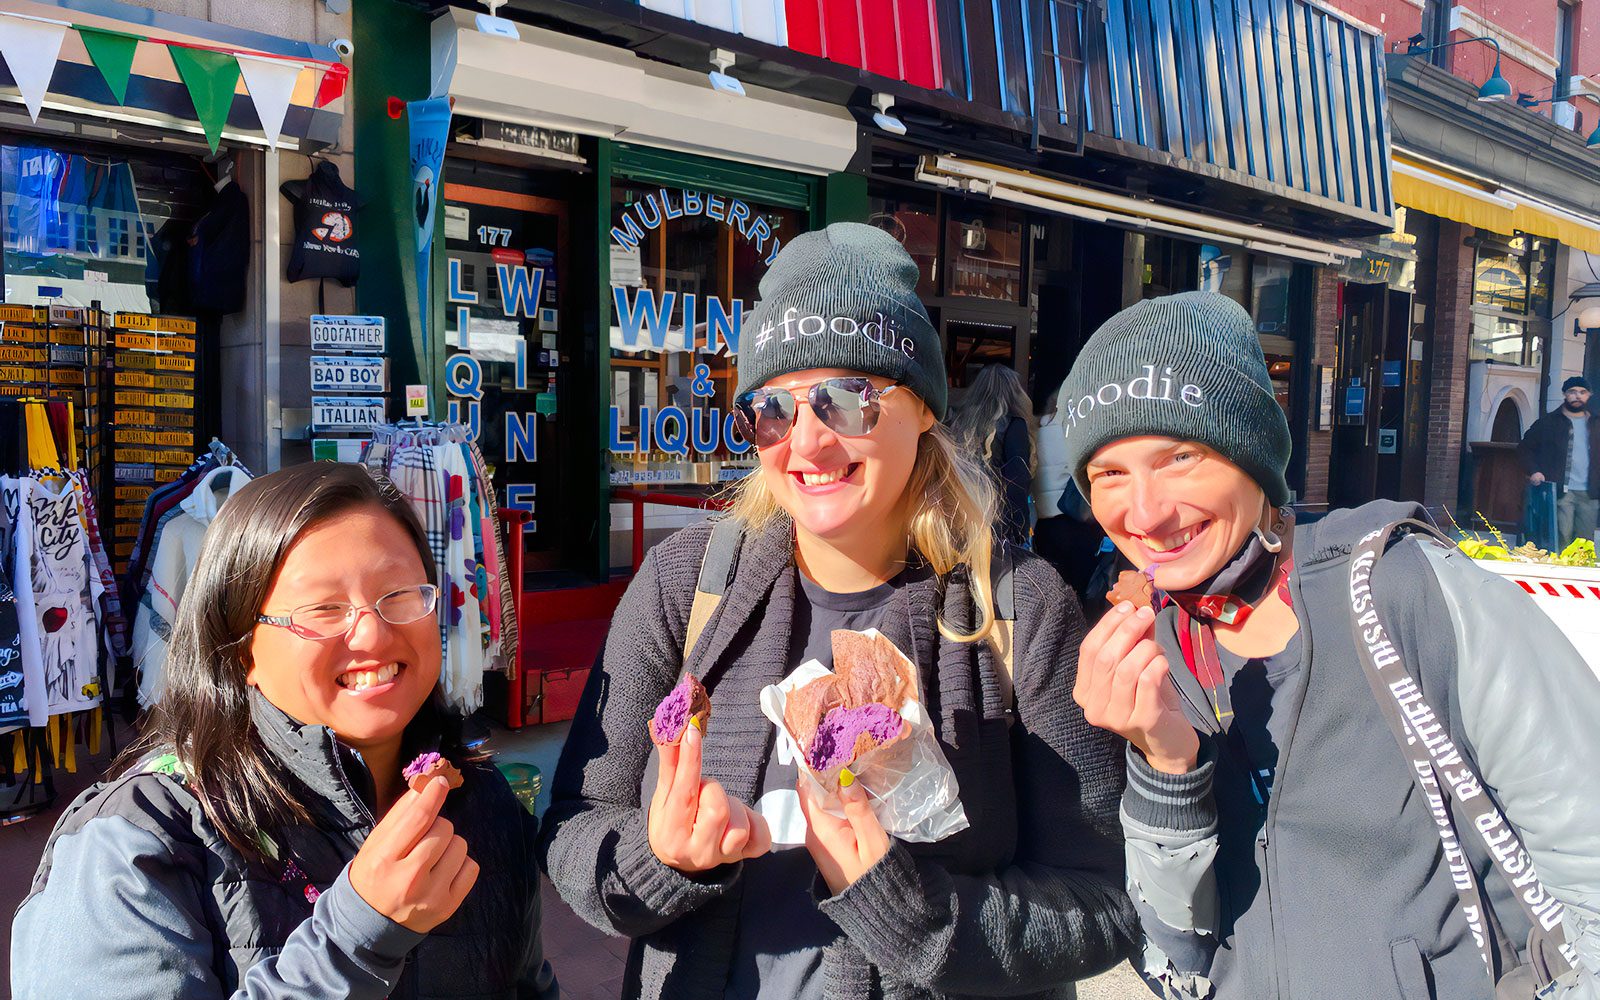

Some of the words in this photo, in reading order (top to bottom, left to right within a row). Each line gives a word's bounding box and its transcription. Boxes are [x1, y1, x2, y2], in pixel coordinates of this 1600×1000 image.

[477, 225, 512, 247] 177
[610, 188, 781, 266] MULBERRY
[1367, 258, 1391, 280] 177
[314, 326, 381, 342] GODFATHER
[755, 307, 915, 360] #foodie
[314, 368, 345, 382] BAD
[350, 368, 380, 383] BOY
[691, 363, 717, 398] &
[496, 263, 545, 533] WINE
[1065, 364, 1204, 438] foodie
[321, 408, 377, 423] ITALIAN
